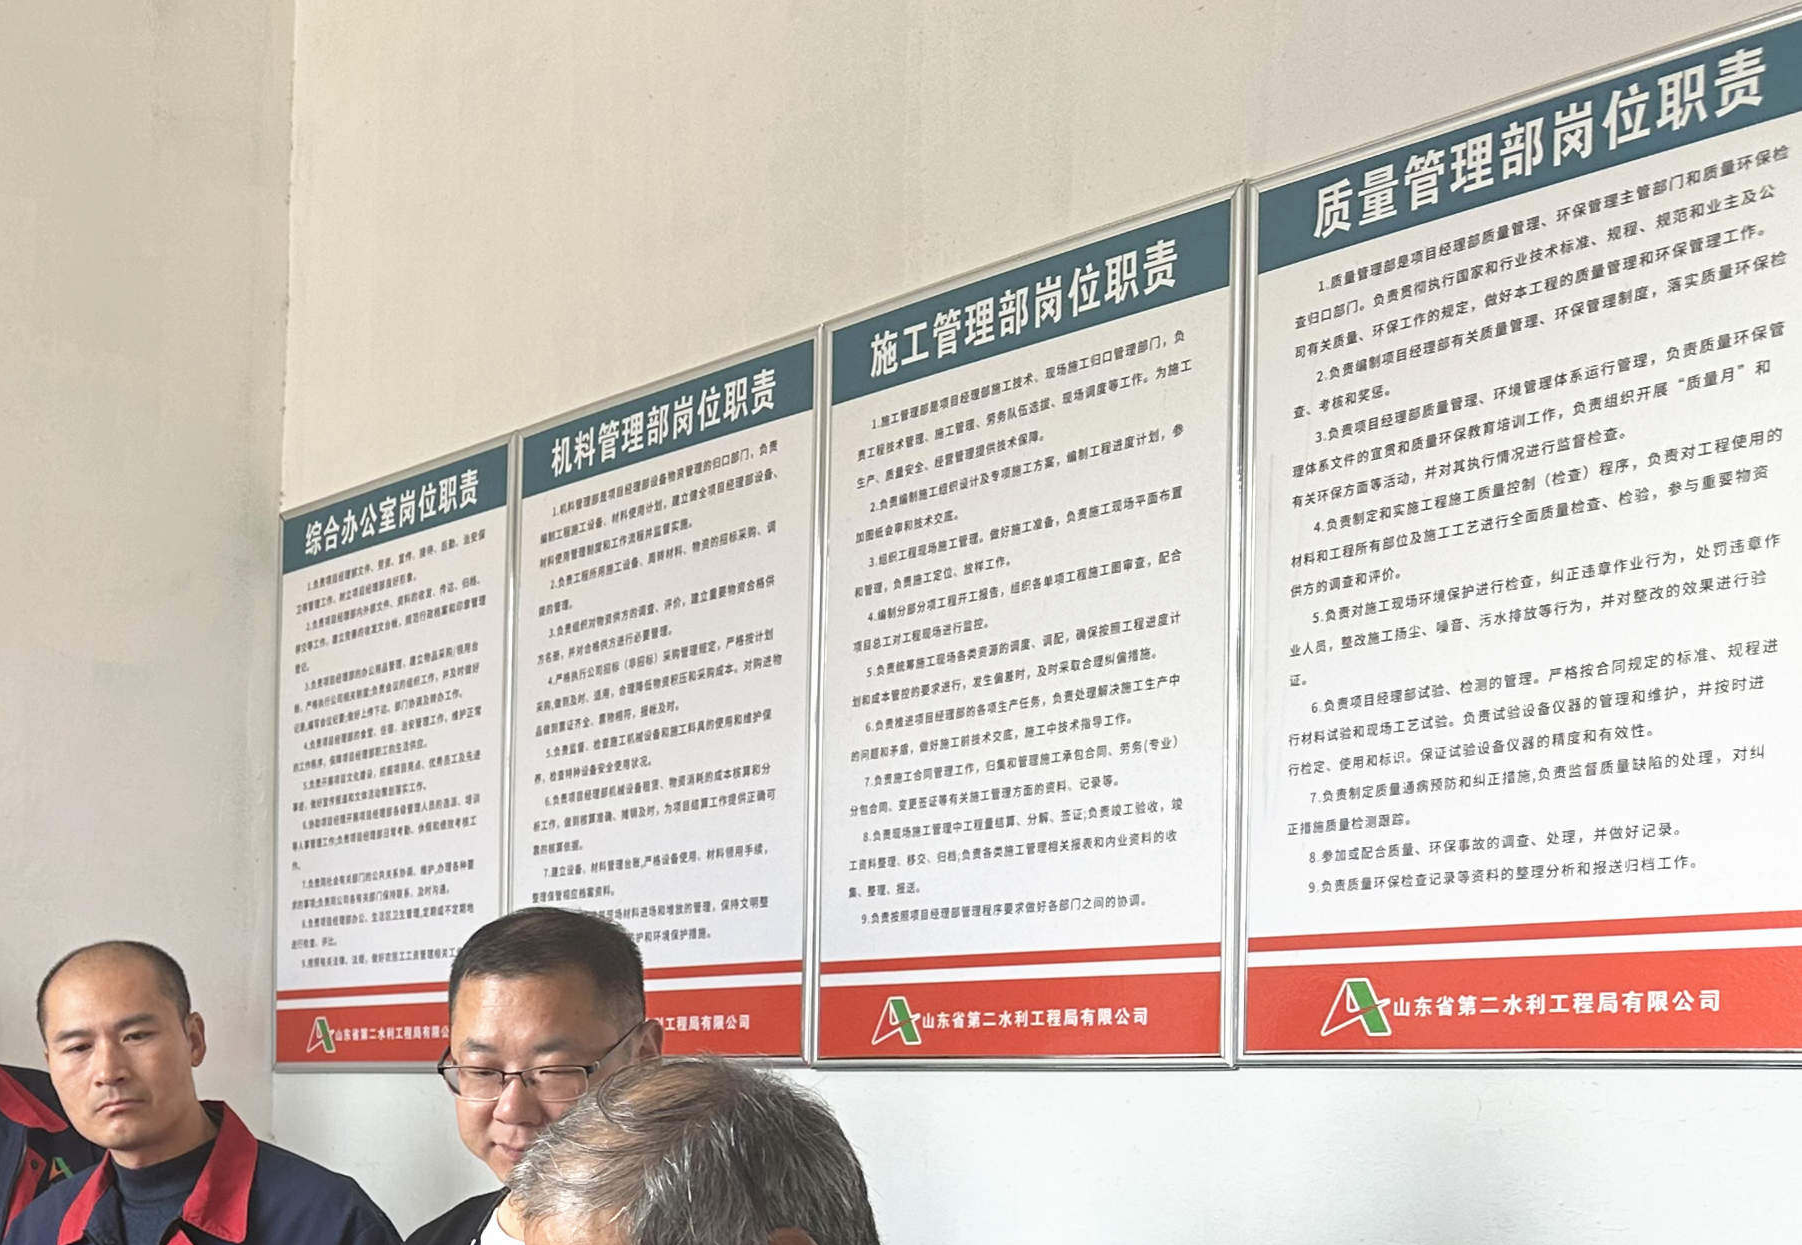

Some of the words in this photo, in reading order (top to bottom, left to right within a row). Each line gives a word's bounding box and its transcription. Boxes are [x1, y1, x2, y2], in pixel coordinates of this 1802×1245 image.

[1312, 46, 1766, 239] 质量管理部岗位职责
[870, 238, 1178, 378] 施工管理部岗位职责
[1293, 383, 1391, 421] 查、考核和奖惩。
[550, 368, 777, 478] 机料管理部岗位职责
[304, 467, 479, 556] 综合办公室岗位职责
[1289, 566, 1402, 599] 供方的调查和评价。
[1288, 673, 1308, 688] 证。
[1286, 811, 1412, 837] 正措施质量检测跟踪。
[921, 1005, 1149, 1029] 山东省第二水利工程局有限公司
[1393, 989, 1721, 1018] 山东省第二水利工程局有限公司
